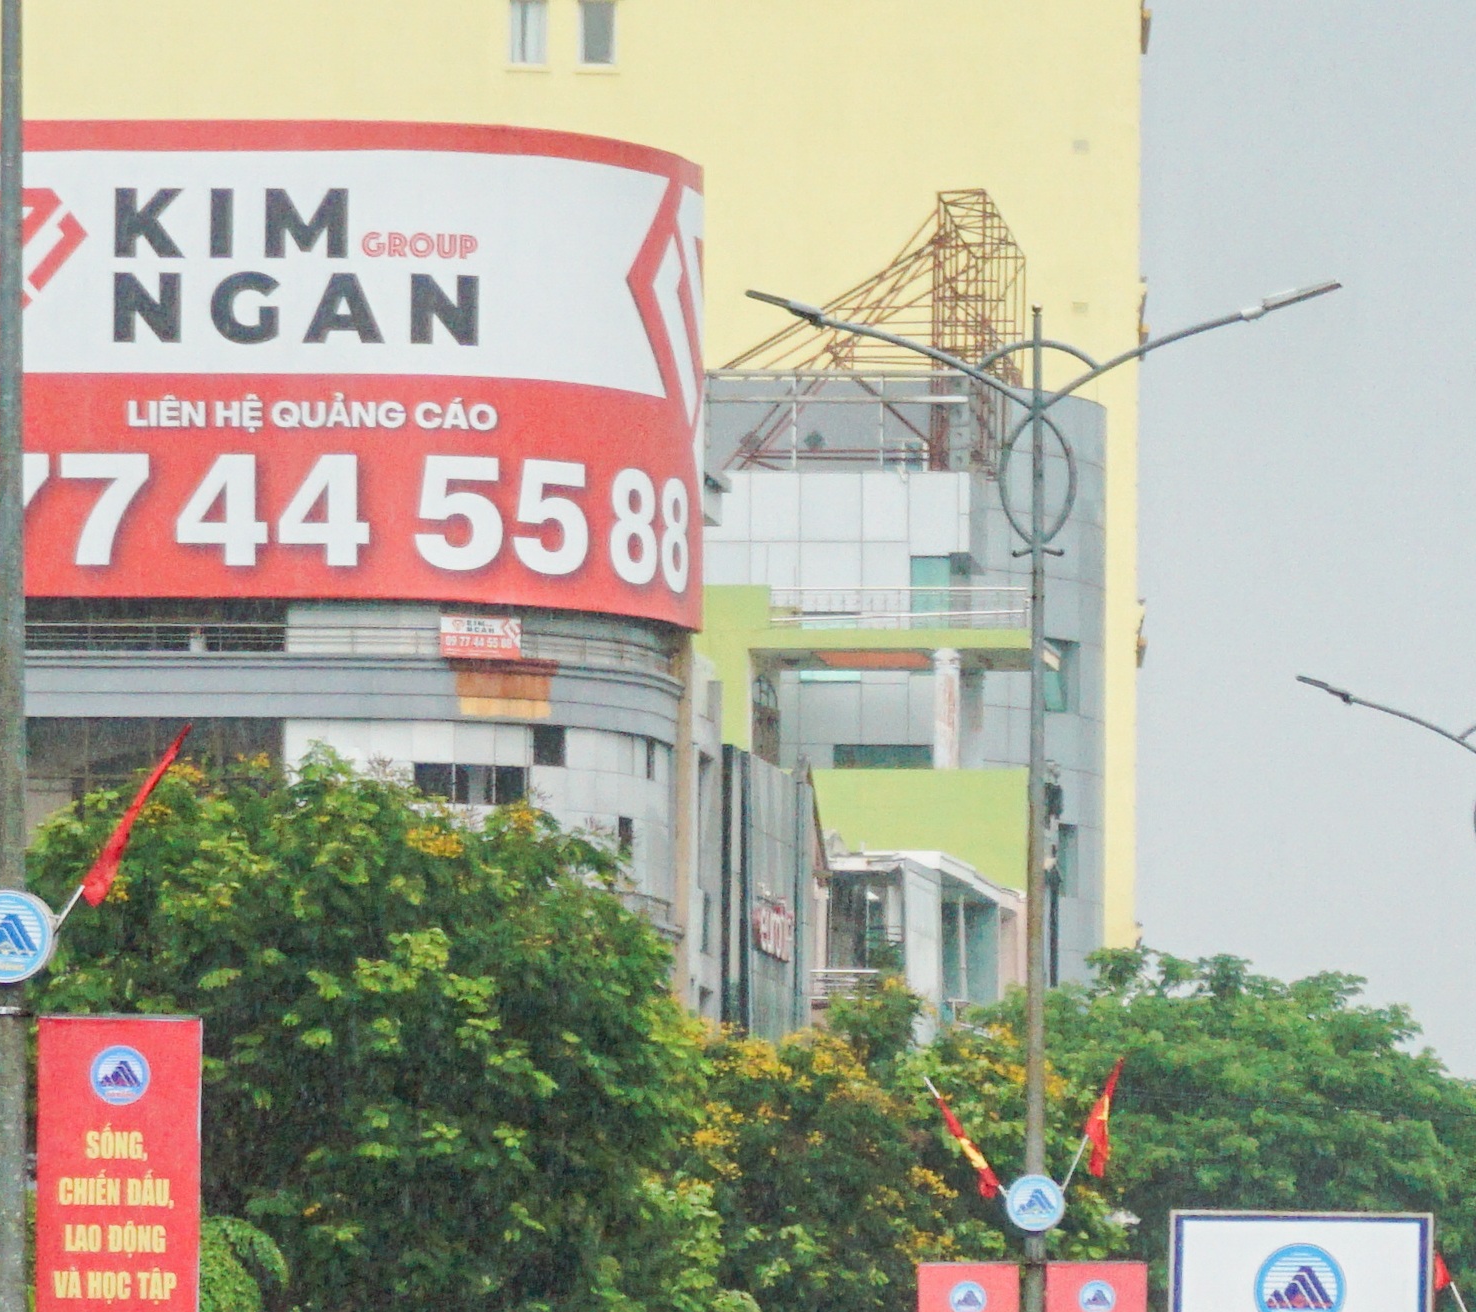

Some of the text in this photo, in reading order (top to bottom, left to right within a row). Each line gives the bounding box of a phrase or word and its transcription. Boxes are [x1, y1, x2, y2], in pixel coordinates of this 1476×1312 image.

[114, 186, 478, 260] KIM GROUP
[112, 269, 479, 347] NGAN
[127, 392, 498, 437] LIÊN HỆ QUẢNG CÁO
[175, 453, 371, 566] 44
[414, 454, 590, 575] 55
[609, 467, 690, 594] 88
[85, 1122, 148, 1162] SỐNG,
[58, 1169, 174, 1209] CHIẾN ĐẤU,
[64, 1221, 166, 1258] LAO ĐỘNG
[53, 1266, 177, 1305] VÀ HỌC TẬP
